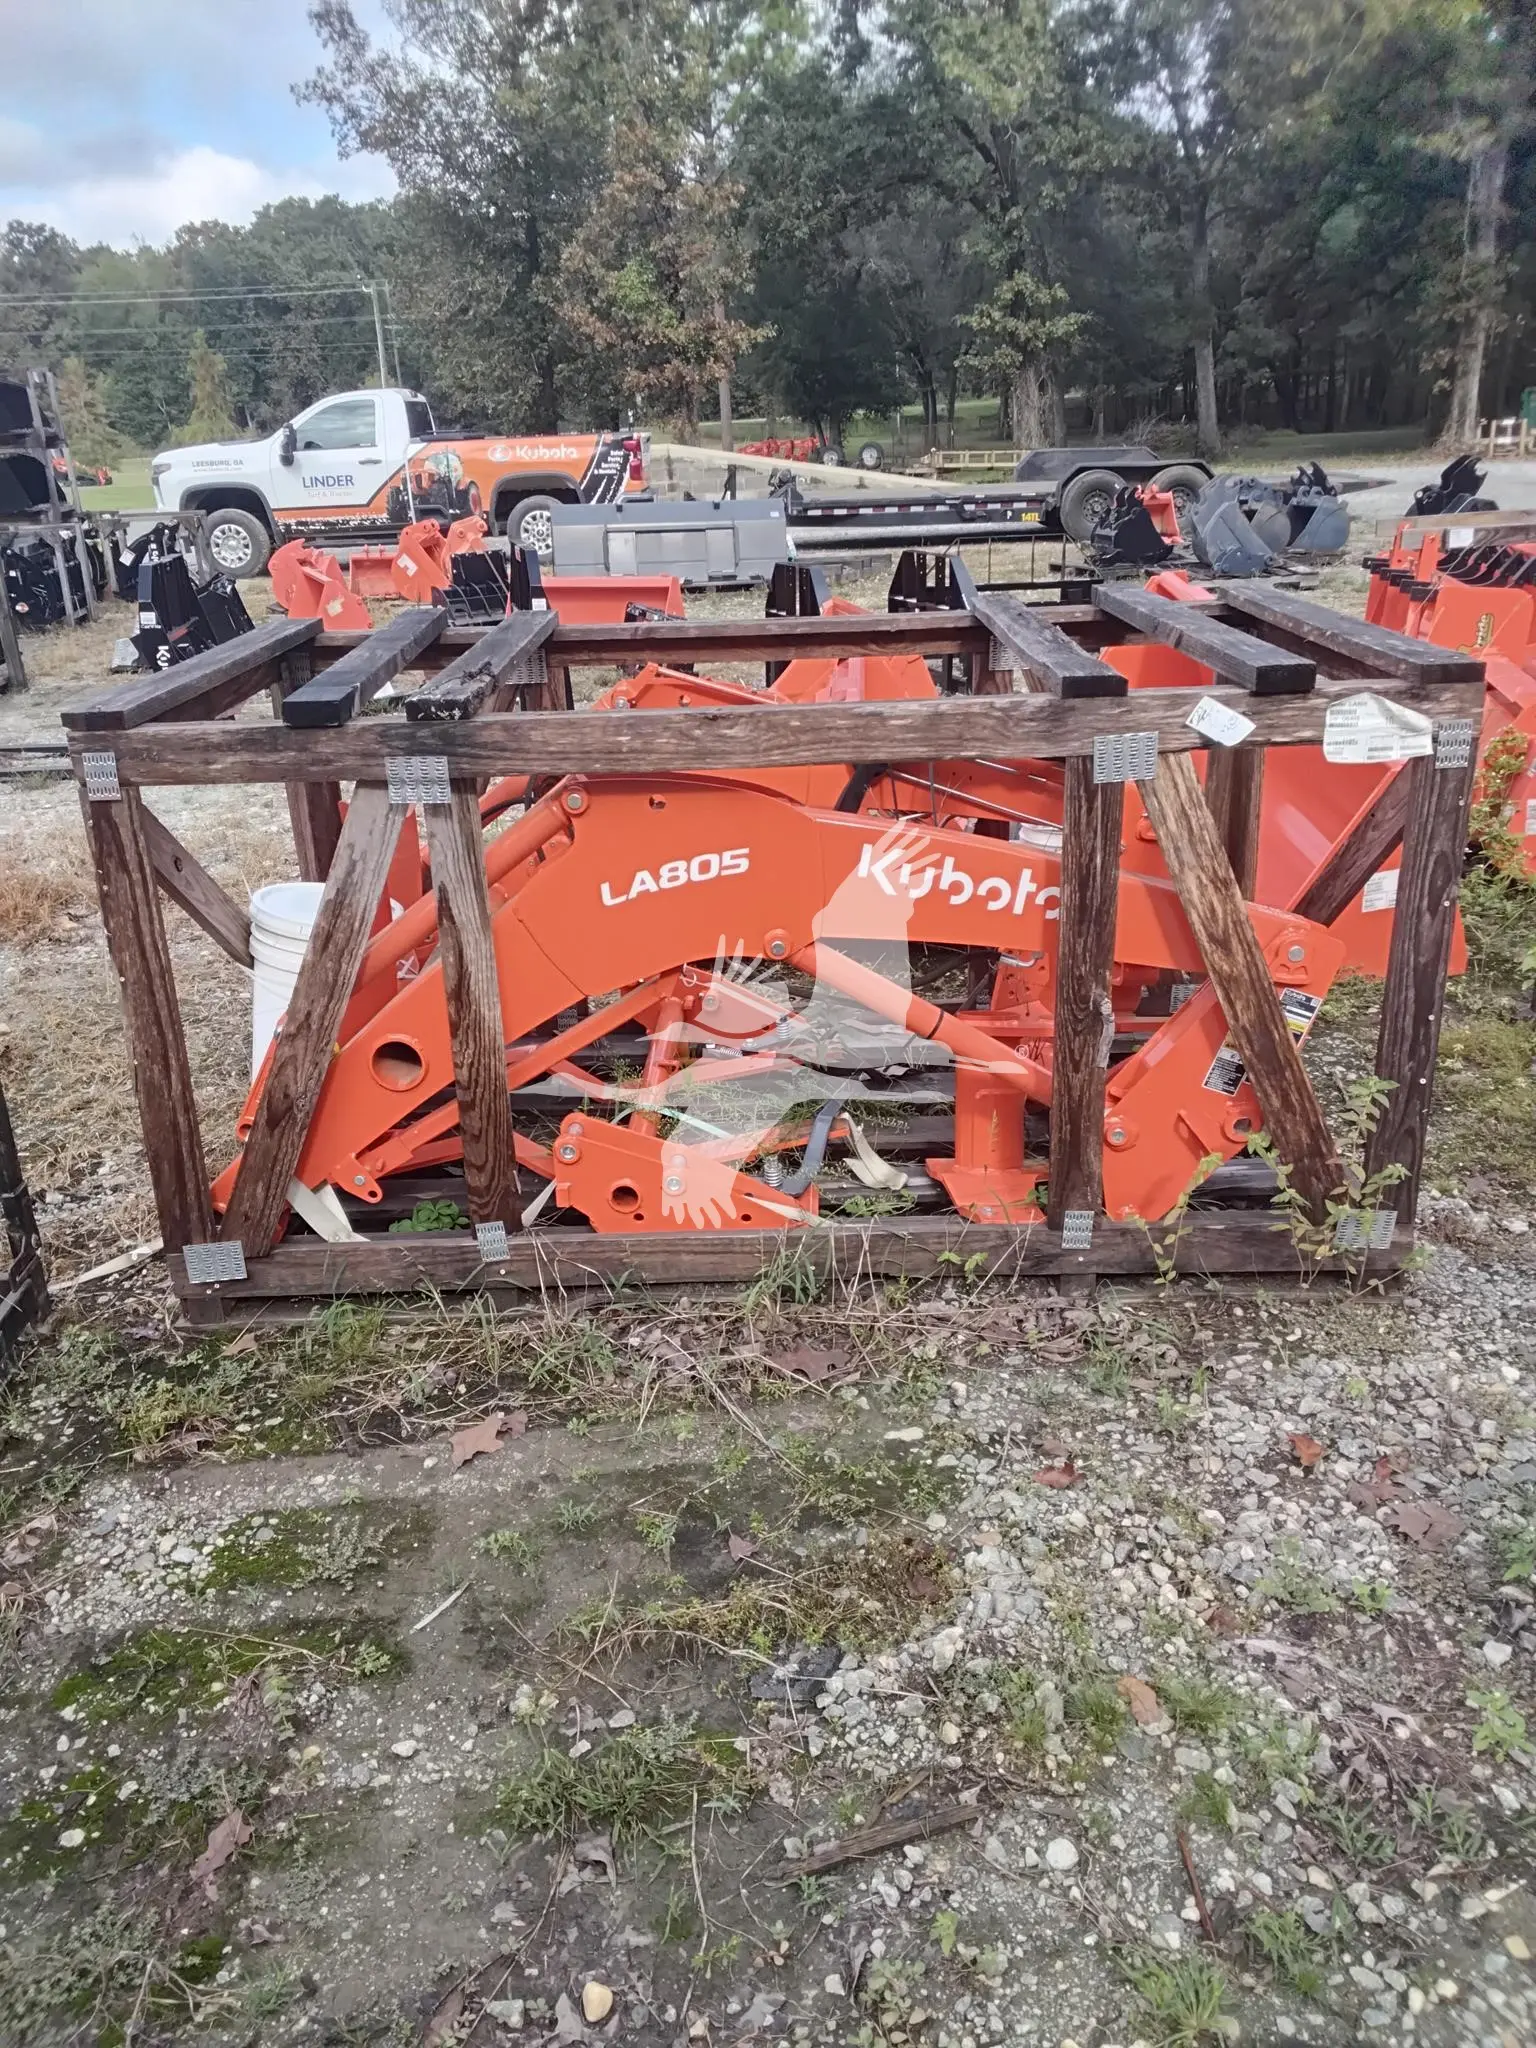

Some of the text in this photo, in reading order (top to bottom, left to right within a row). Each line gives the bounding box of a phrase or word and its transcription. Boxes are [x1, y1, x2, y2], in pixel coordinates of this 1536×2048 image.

[516, 443, 578, 460] Kubota
[302, 474, 355, 489] LINDER
[600, 847, 750, 906] LA805
